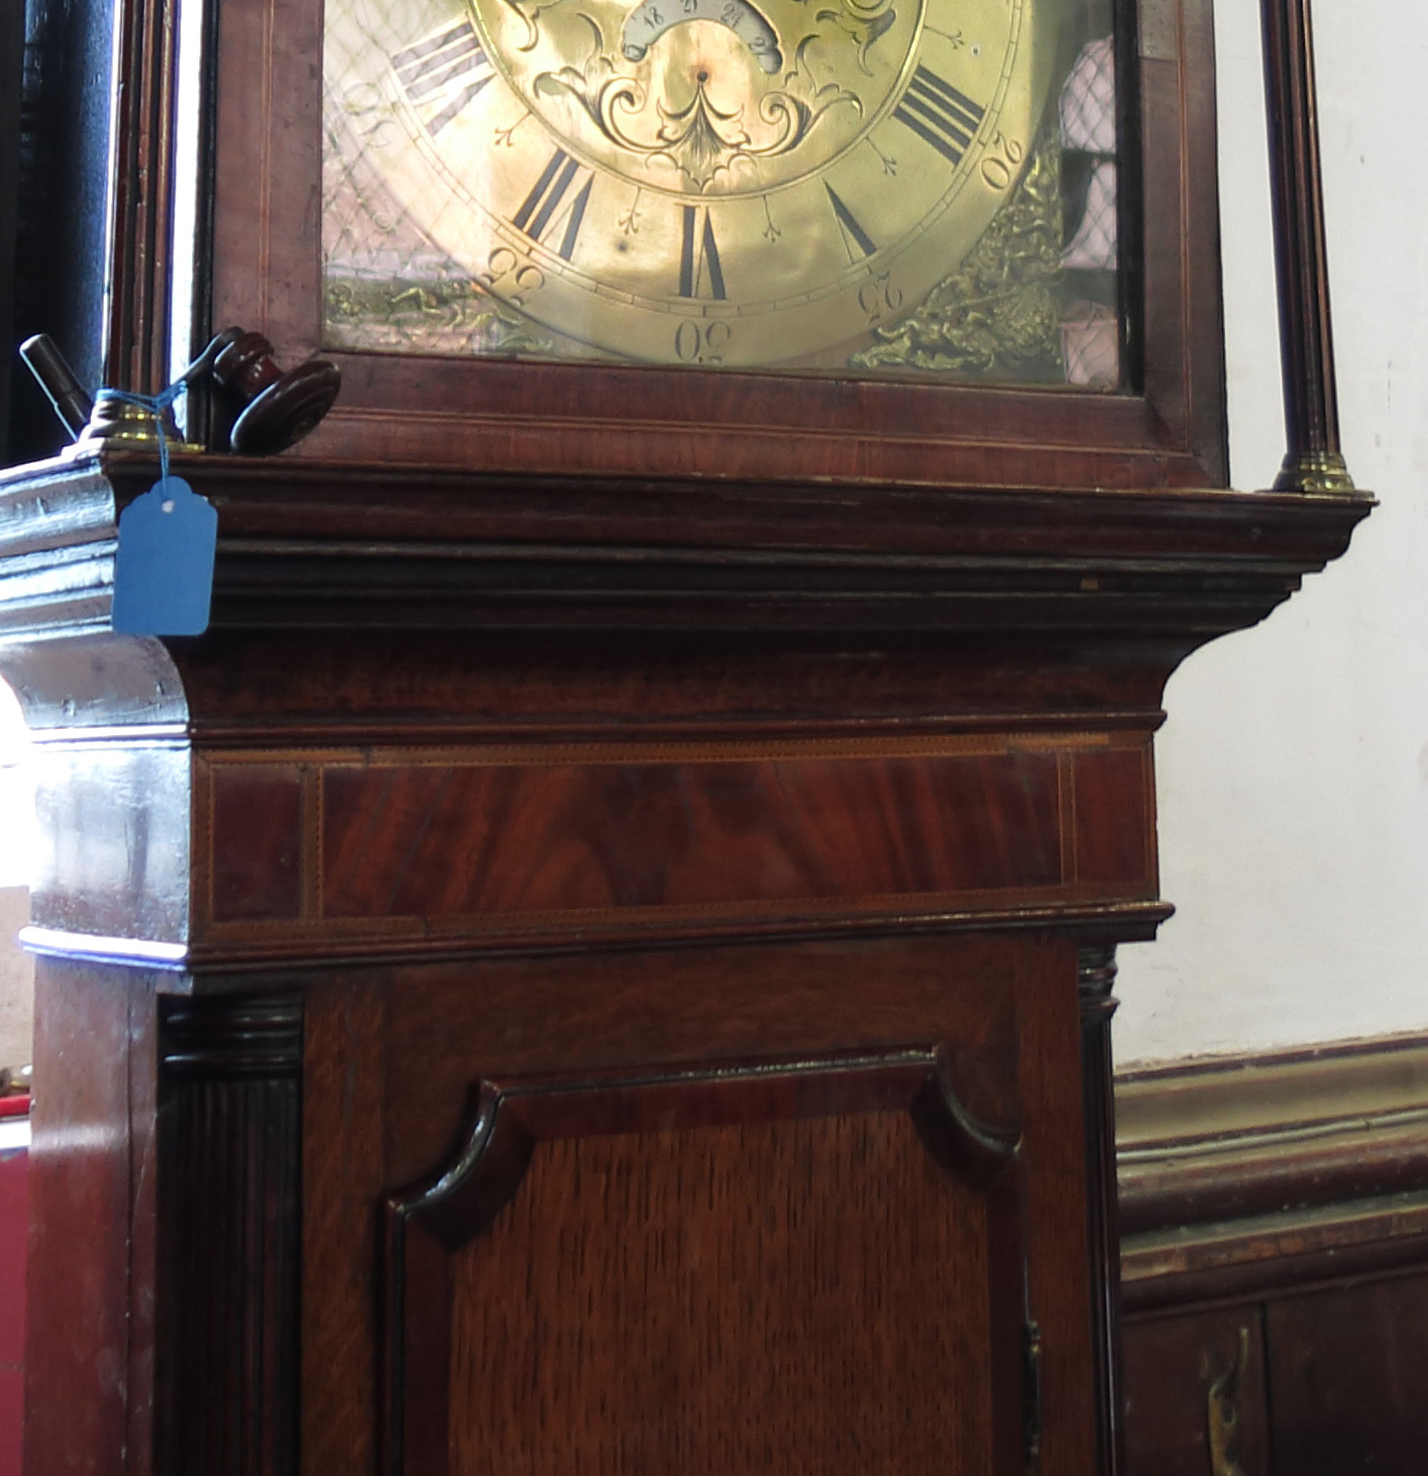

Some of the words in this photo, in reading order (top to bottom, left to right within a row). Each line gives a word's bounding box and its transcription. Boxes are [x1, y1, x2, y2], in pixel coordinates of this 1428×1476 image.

[642, 6, 665, 31] 18
[888, 58, 989, 174] IIII
[979, 130, 1023, 191] 20
[502, 137, 597, 268] VII
[820, 177, 885, 272] V
[668, 202, 730, 301] VI
[674, 320, 732, 364] 30
